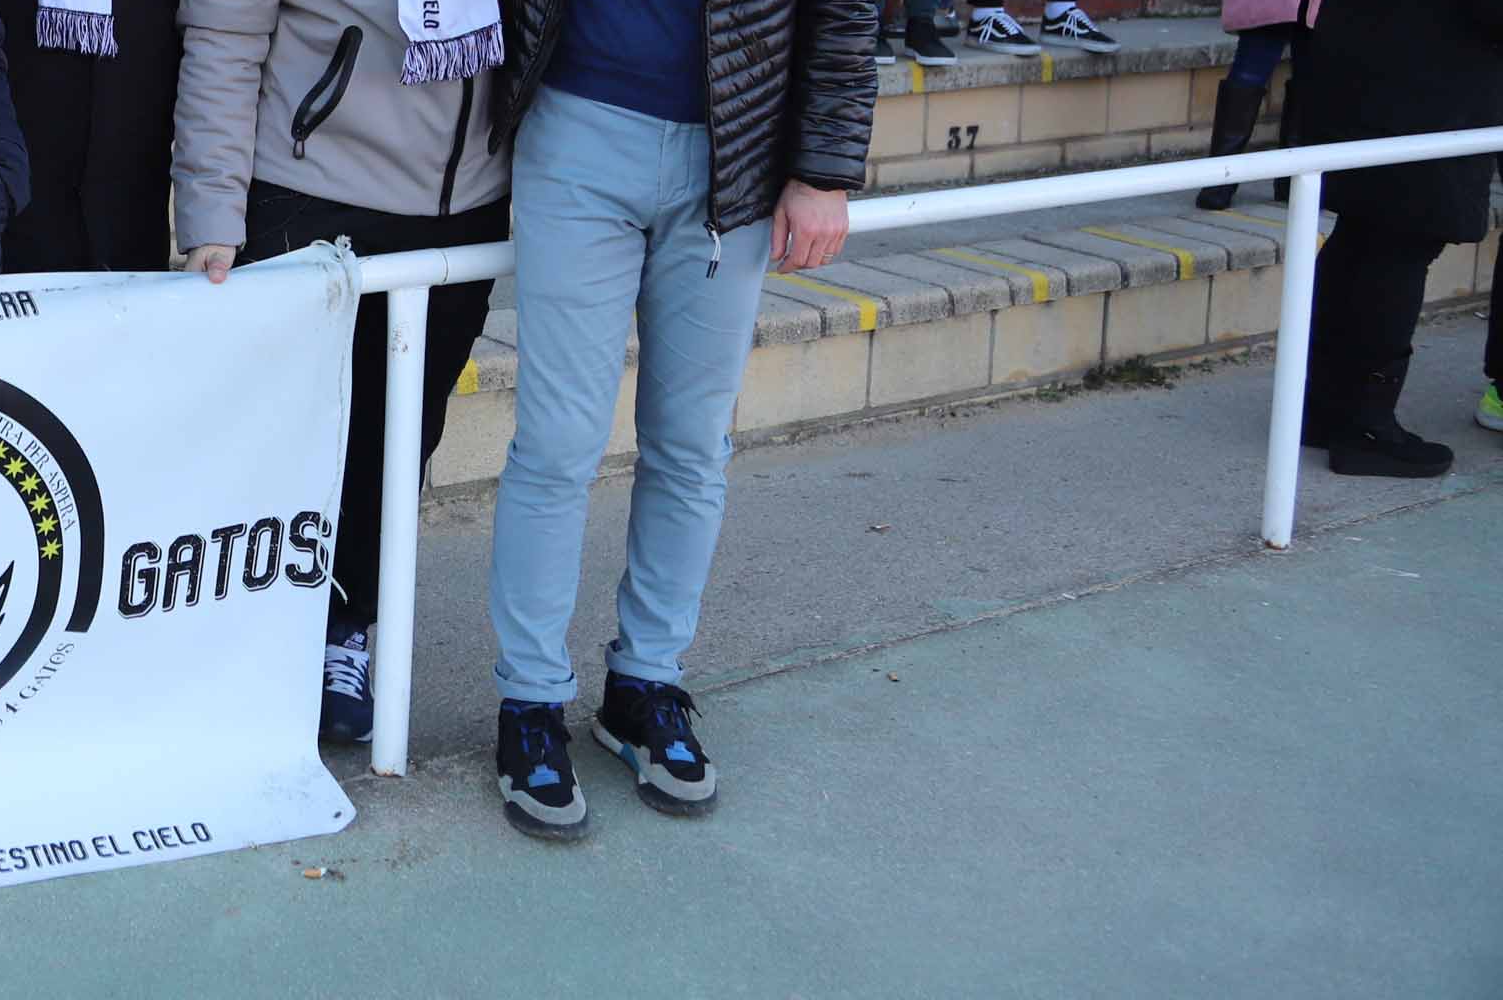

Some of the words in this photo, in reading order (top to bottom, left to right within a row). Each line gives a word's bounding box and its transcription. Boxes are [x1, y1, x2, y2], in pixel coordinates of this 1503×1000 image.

[947, 125, 979, 151] 37
[24, 439, 50, 470] PER
[48, 470, 76, 531] ASPERA
[117, 510, 332, 620] GATOS
[18, 641, 76, 700] GATOS
[91, 833, 131, 859] EL
[132, 821, 212, 853] CIELO
